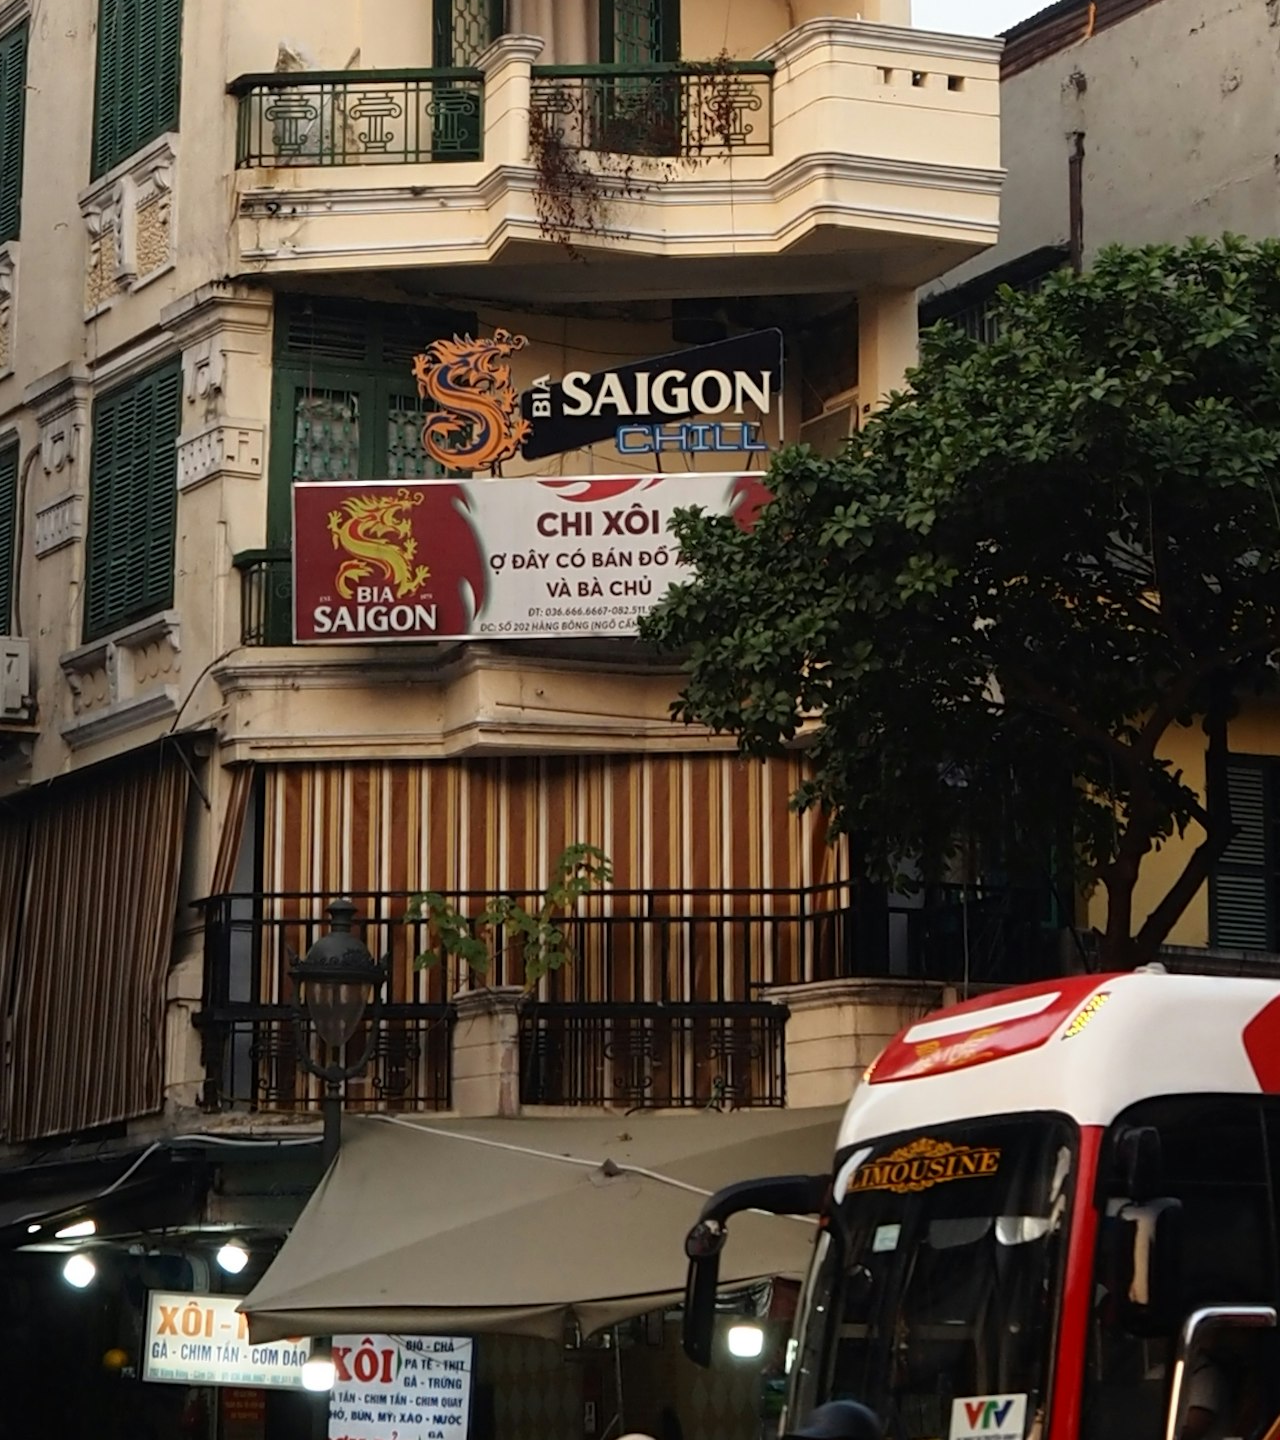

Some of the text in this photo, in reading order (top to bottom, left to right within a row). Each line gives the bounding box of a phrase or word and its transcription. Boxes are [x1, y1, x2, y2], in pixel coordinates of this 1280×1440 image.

[532, 370, 772, 418] BIA SAIGON
[617, 421, 768, 454] CHILL
[536, 503, 660, 538] CHI XÔI
[511, 550, 550, 570] ĐÂY
[556, 548, 586, 569] CÓ
[591, 547, 633, 568] BÁN
[356, 586, 395, 604] BIA
[546, 578, 572, 598] VÀ
[578, 577, 604, 597] BÀ
[313, 604, 438, 634] SAIGON
[849, 1151, 1001, 1189] LIMOUSINE
[156, 1301, 214, 1338] XÔI
[332, 1337, 395, 1384] XÔI
[963, 1400, 1014, 1430] VTV
